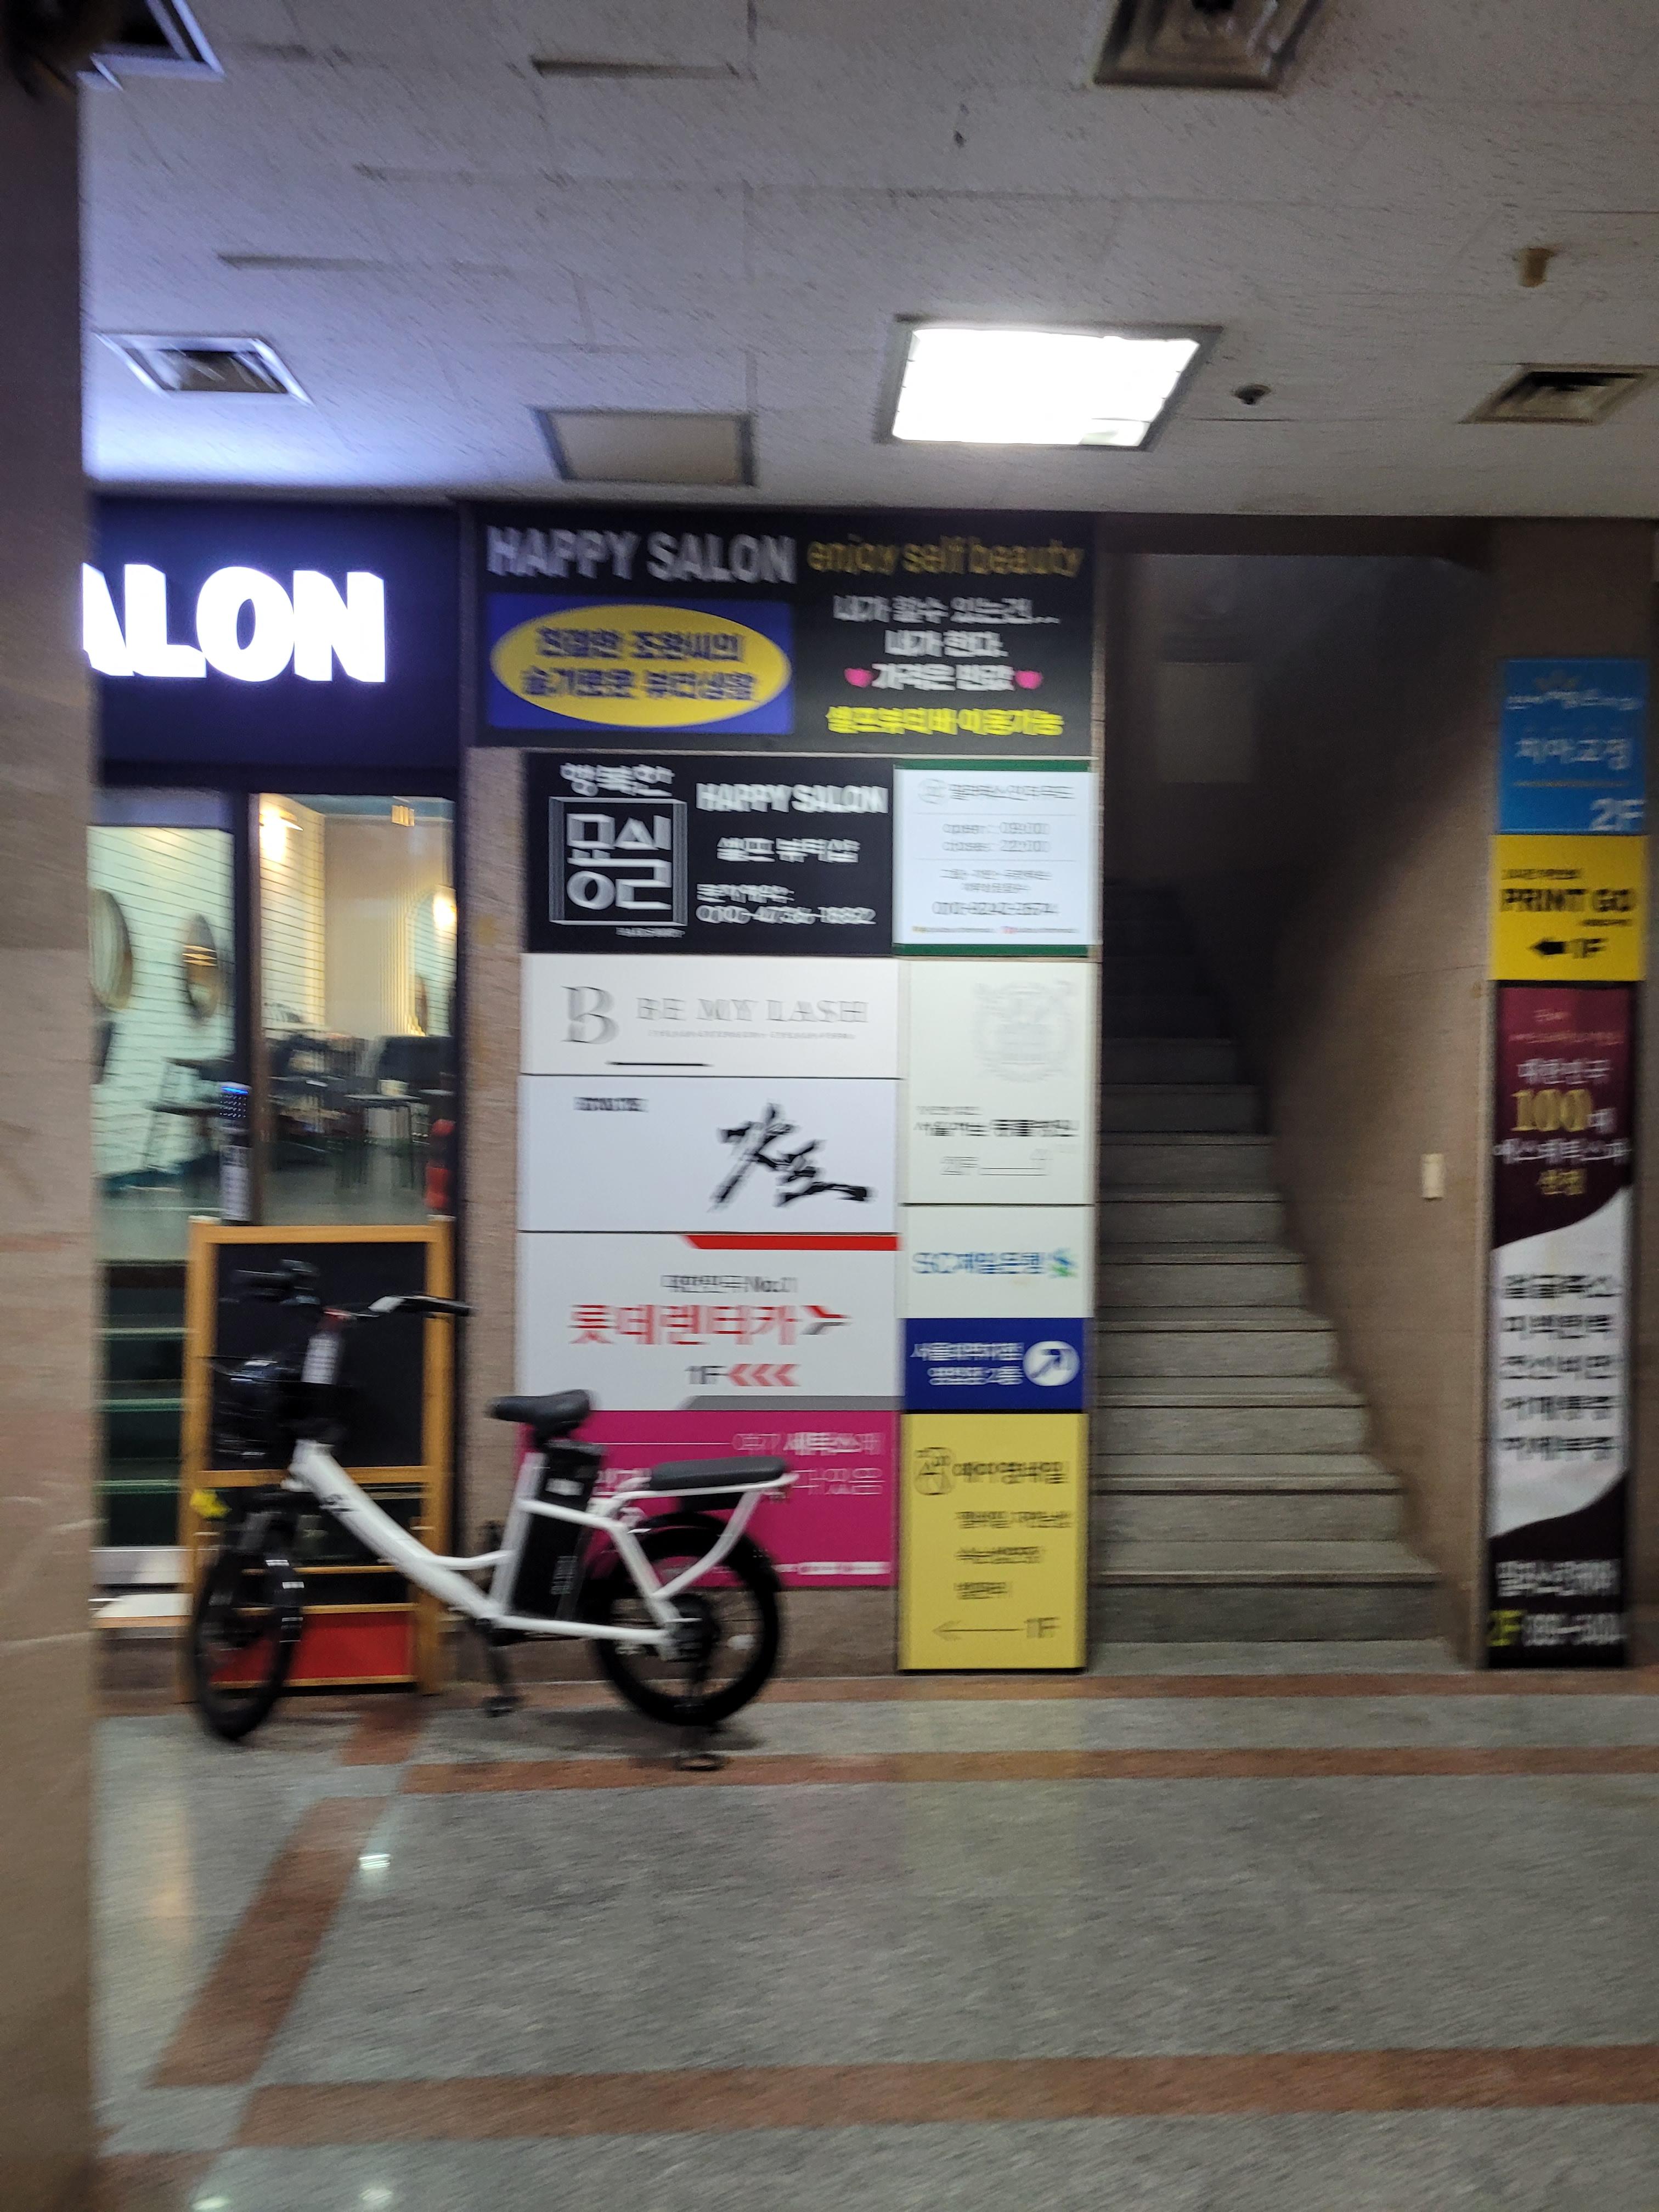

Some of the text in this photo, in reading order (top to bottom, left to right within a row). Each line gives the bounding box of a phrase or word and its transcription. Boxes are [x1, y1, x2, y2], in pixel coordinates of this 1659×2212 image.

[486, 527, 796, 584] HAPPY SALON
[806, 533, 1085, 578] enjoy self beauty
[560, 762, 676, 798] 행복한
[696, 781, 792, 813] HAPPY
[792, 783, 889, 814] SALON
[1590, 798, 1646, 831] 2F
[1499, 888, 1588, 912] PRINT
[635, 997, 870, 1025] BE MY LASH
[567, 1304, 799, 1346] 롯데렌터카
